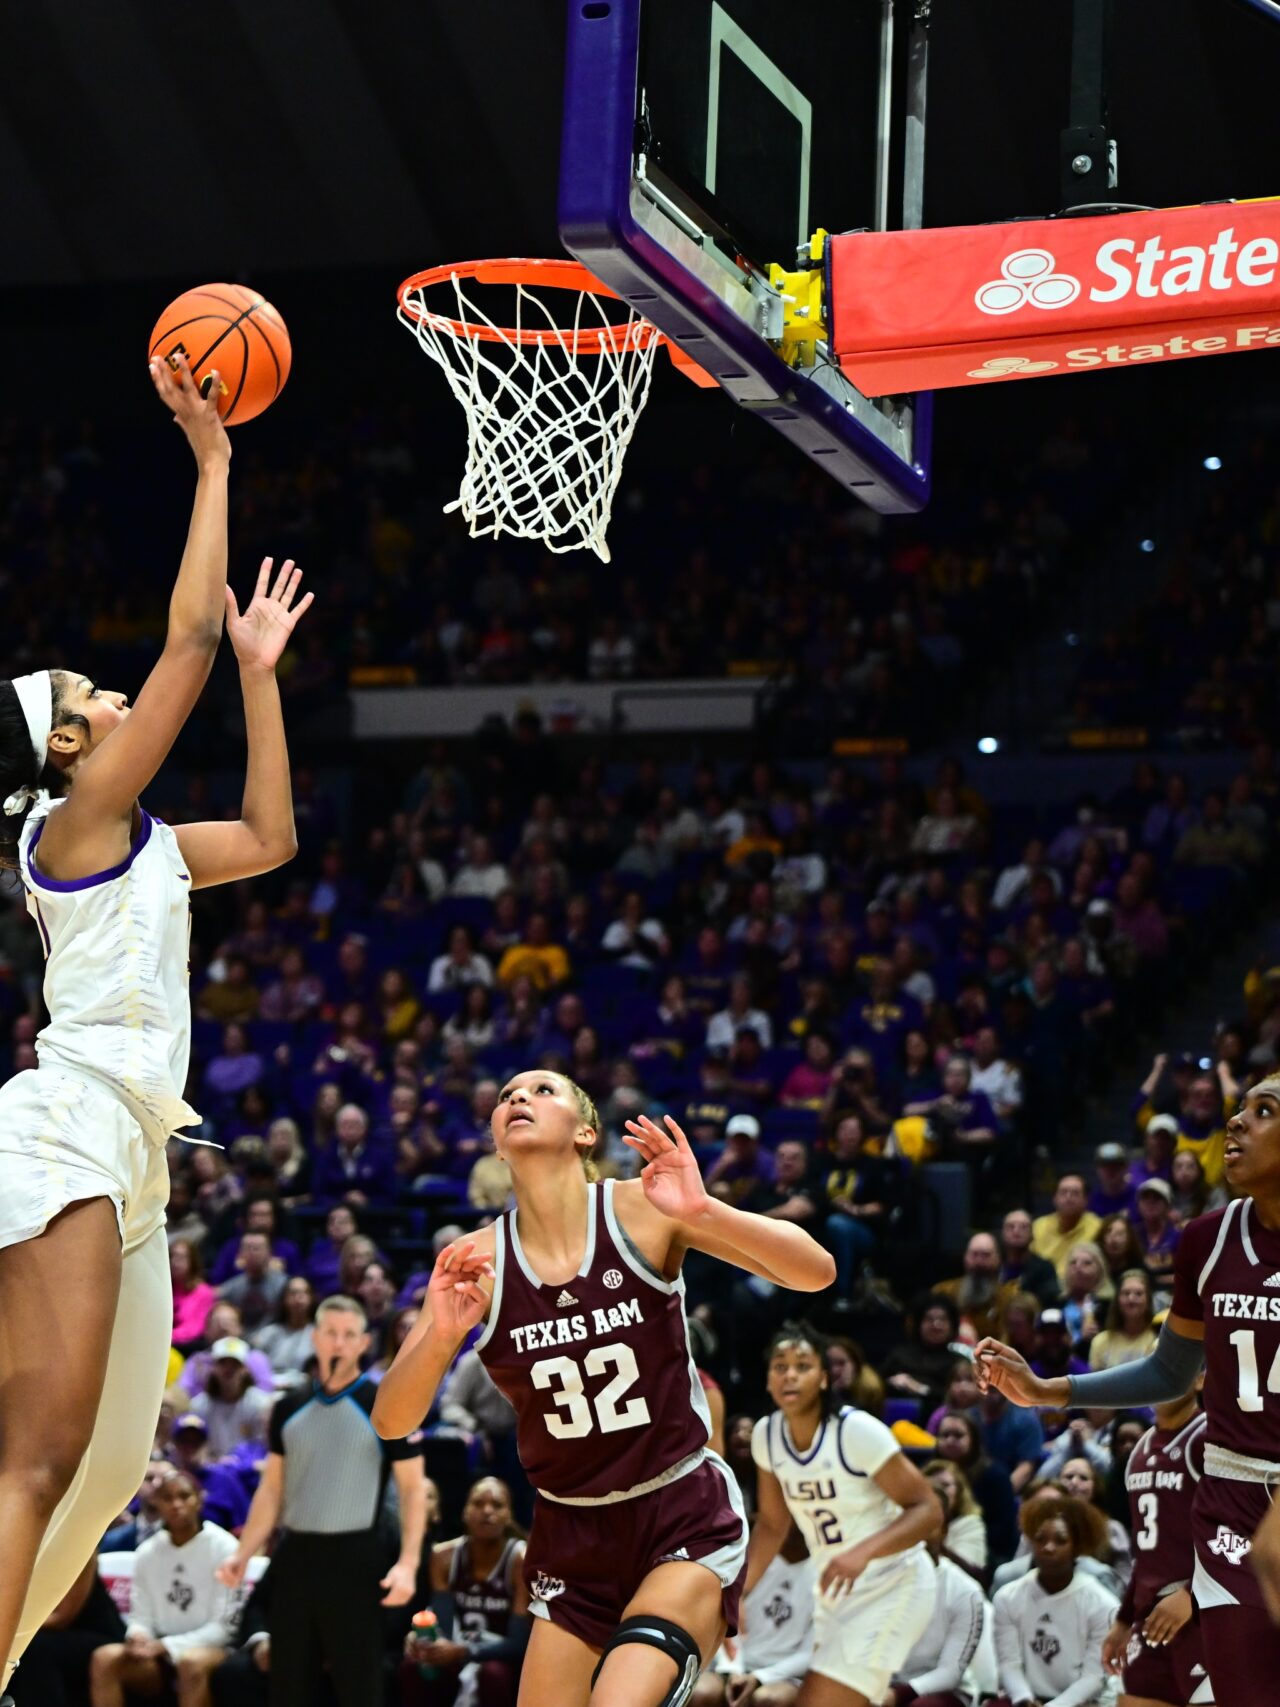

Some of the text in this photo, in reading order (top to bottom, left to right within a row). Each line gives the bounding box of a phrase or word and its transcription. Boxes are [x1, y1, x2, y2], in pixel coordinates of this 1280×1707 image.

[1089, 227, 1279, 303] State
[1065, 336, 1227, 367] State
[603, 1270, 622, 1288] SEC
[509, 1298, 644, 1353] TEXAS A&M
[1212, 1293, 1280, 1322] TEXAS
[530, 1342, 651, 1439] 32
[785, 1479, 837, 1500] LSU
[1136, 1492, 1158, 1551] 3
